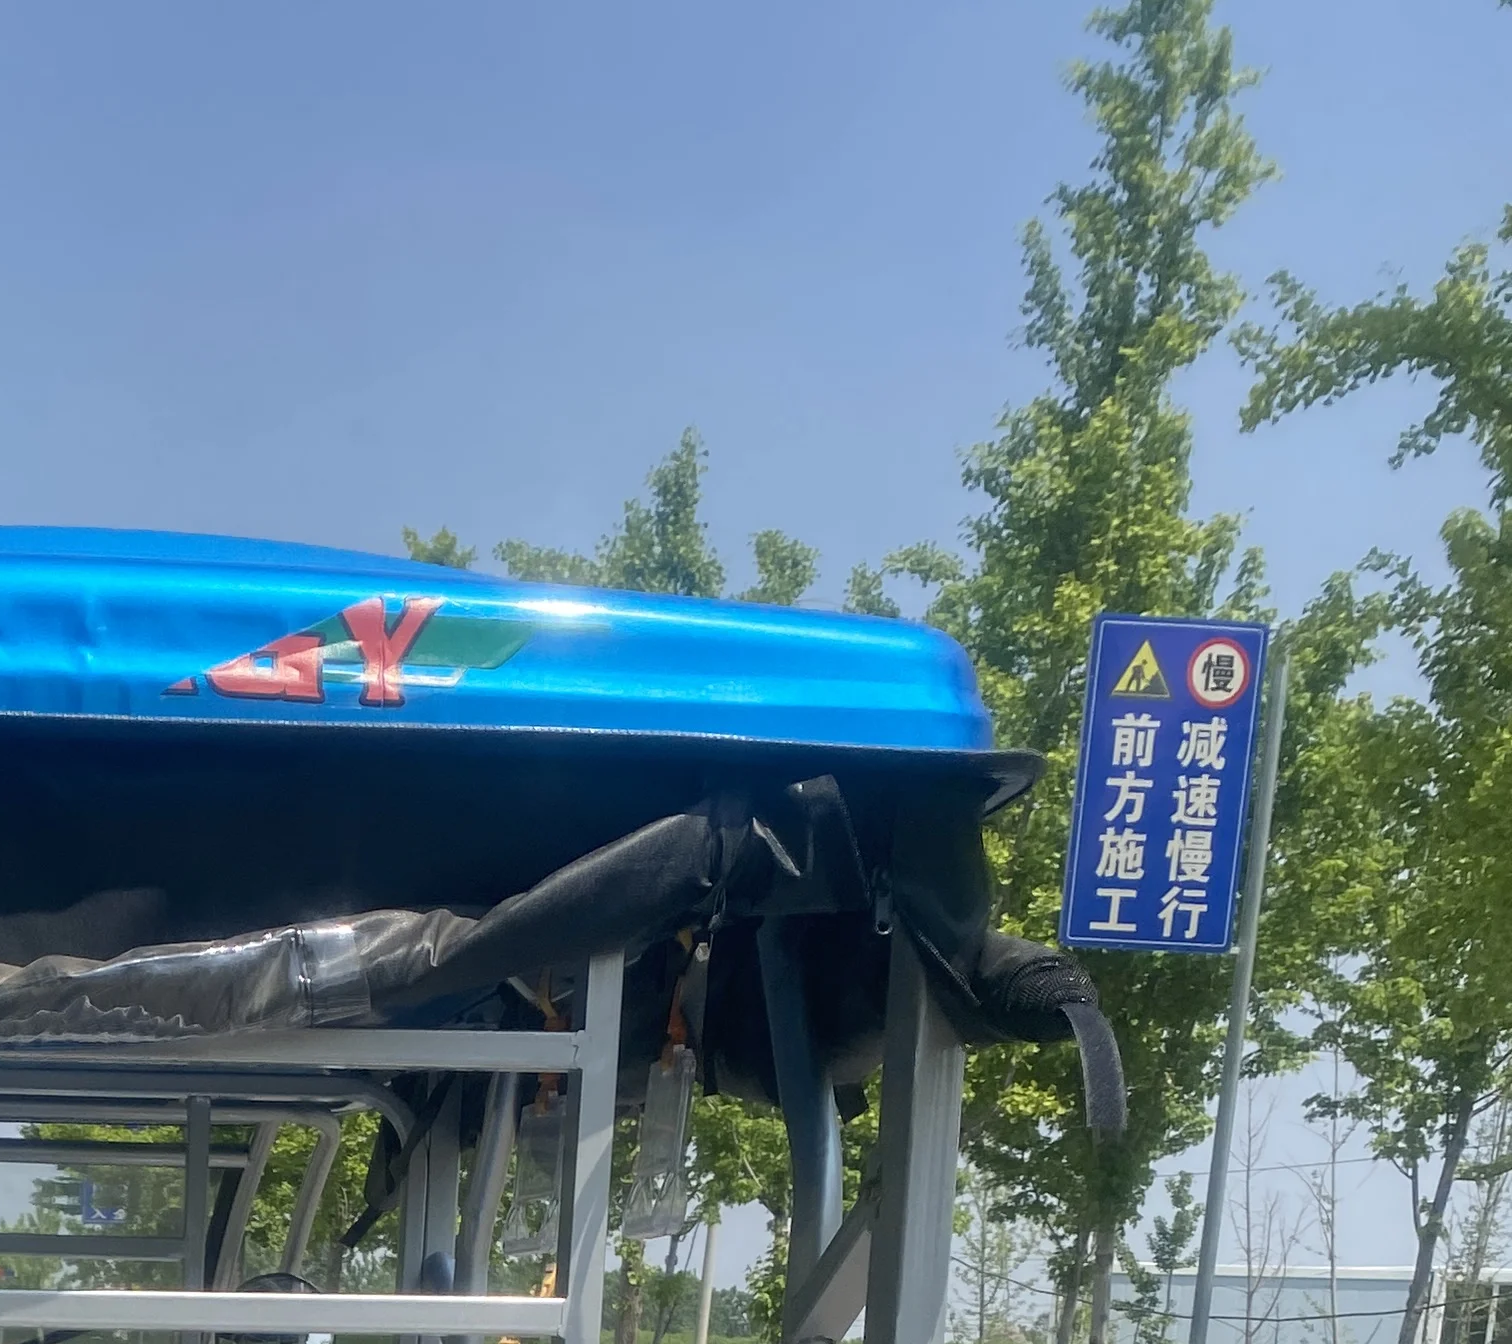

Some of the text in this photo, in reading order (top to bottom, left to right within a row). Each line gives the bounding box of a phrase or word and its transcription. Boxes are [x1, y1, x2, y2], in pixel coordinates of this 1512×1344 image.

[1201, 653, 1234, 693] 慢
[1089, 713, 1161, 932] 前方施工
[1158, 716, 1228, 939] 减速慢行
